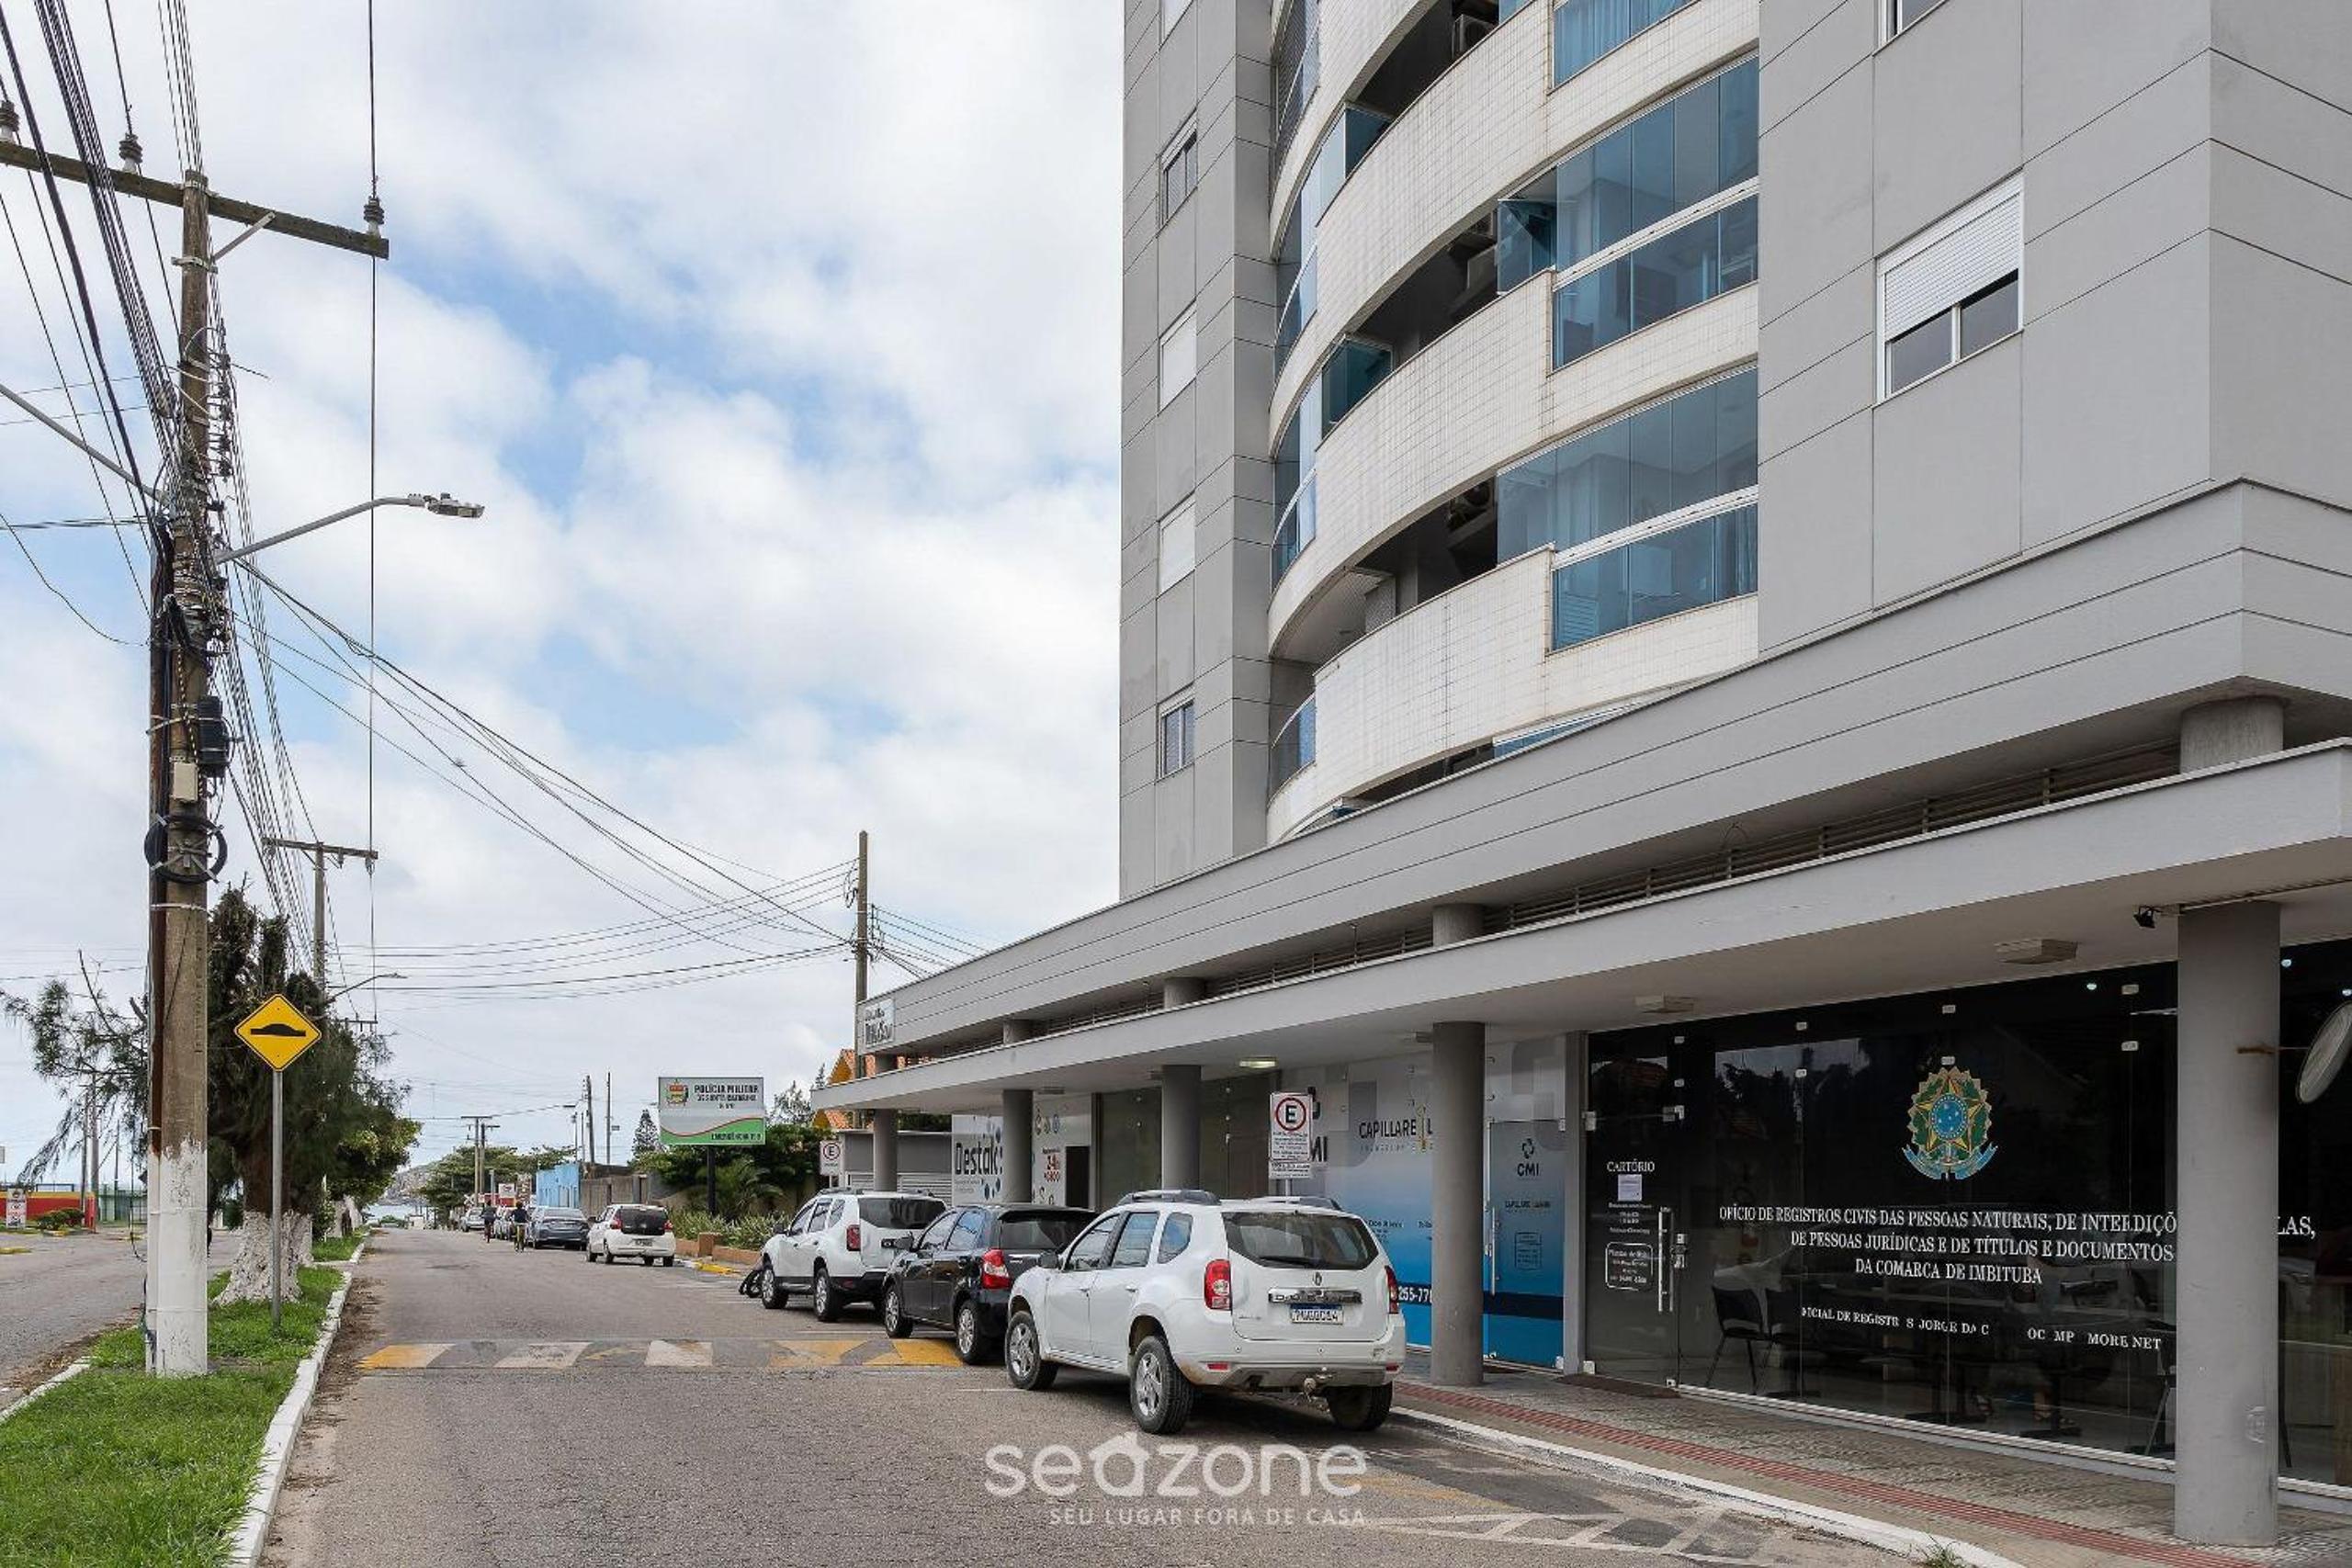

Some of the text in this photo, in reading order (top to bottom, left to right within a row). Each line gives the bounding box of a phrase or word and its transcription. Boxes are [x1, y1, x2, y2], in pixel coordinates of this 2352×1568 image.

[1285, 1105, 1297, 1123] E
[1359, 1119, 1417, 1139] CAPILLARE
[1517, 1163, 1540, 1177] CMI
[1606, 1158, 1656, 1172] CARTÓRIO
[1719, 1203, 1757, 1221] OFÍCIO
[1758, 1206, 1774, 1222] DE
[1776, 1206, 1842, 1224] REGISTROS
[1844, 1209, 1877, 1225] CIVIS
[1880, 1209, 1905, 1226] DAS
[1908, 1211, 1968, 1228] PESSOAS
[1973, 1212, 2052, 1234] NATURAIS,
[2055, 1213, 2077, 1231] DE
[1792, 1231, 2175, 1261] DE PESSOAS JURÍDICAS E DE TÍTULOS E DOCUMENTOS
[1855, 1258, 2042, 1284] DA COMARCA DE IMBITUBA
[1838, 1310, 1851, 1322] DE
